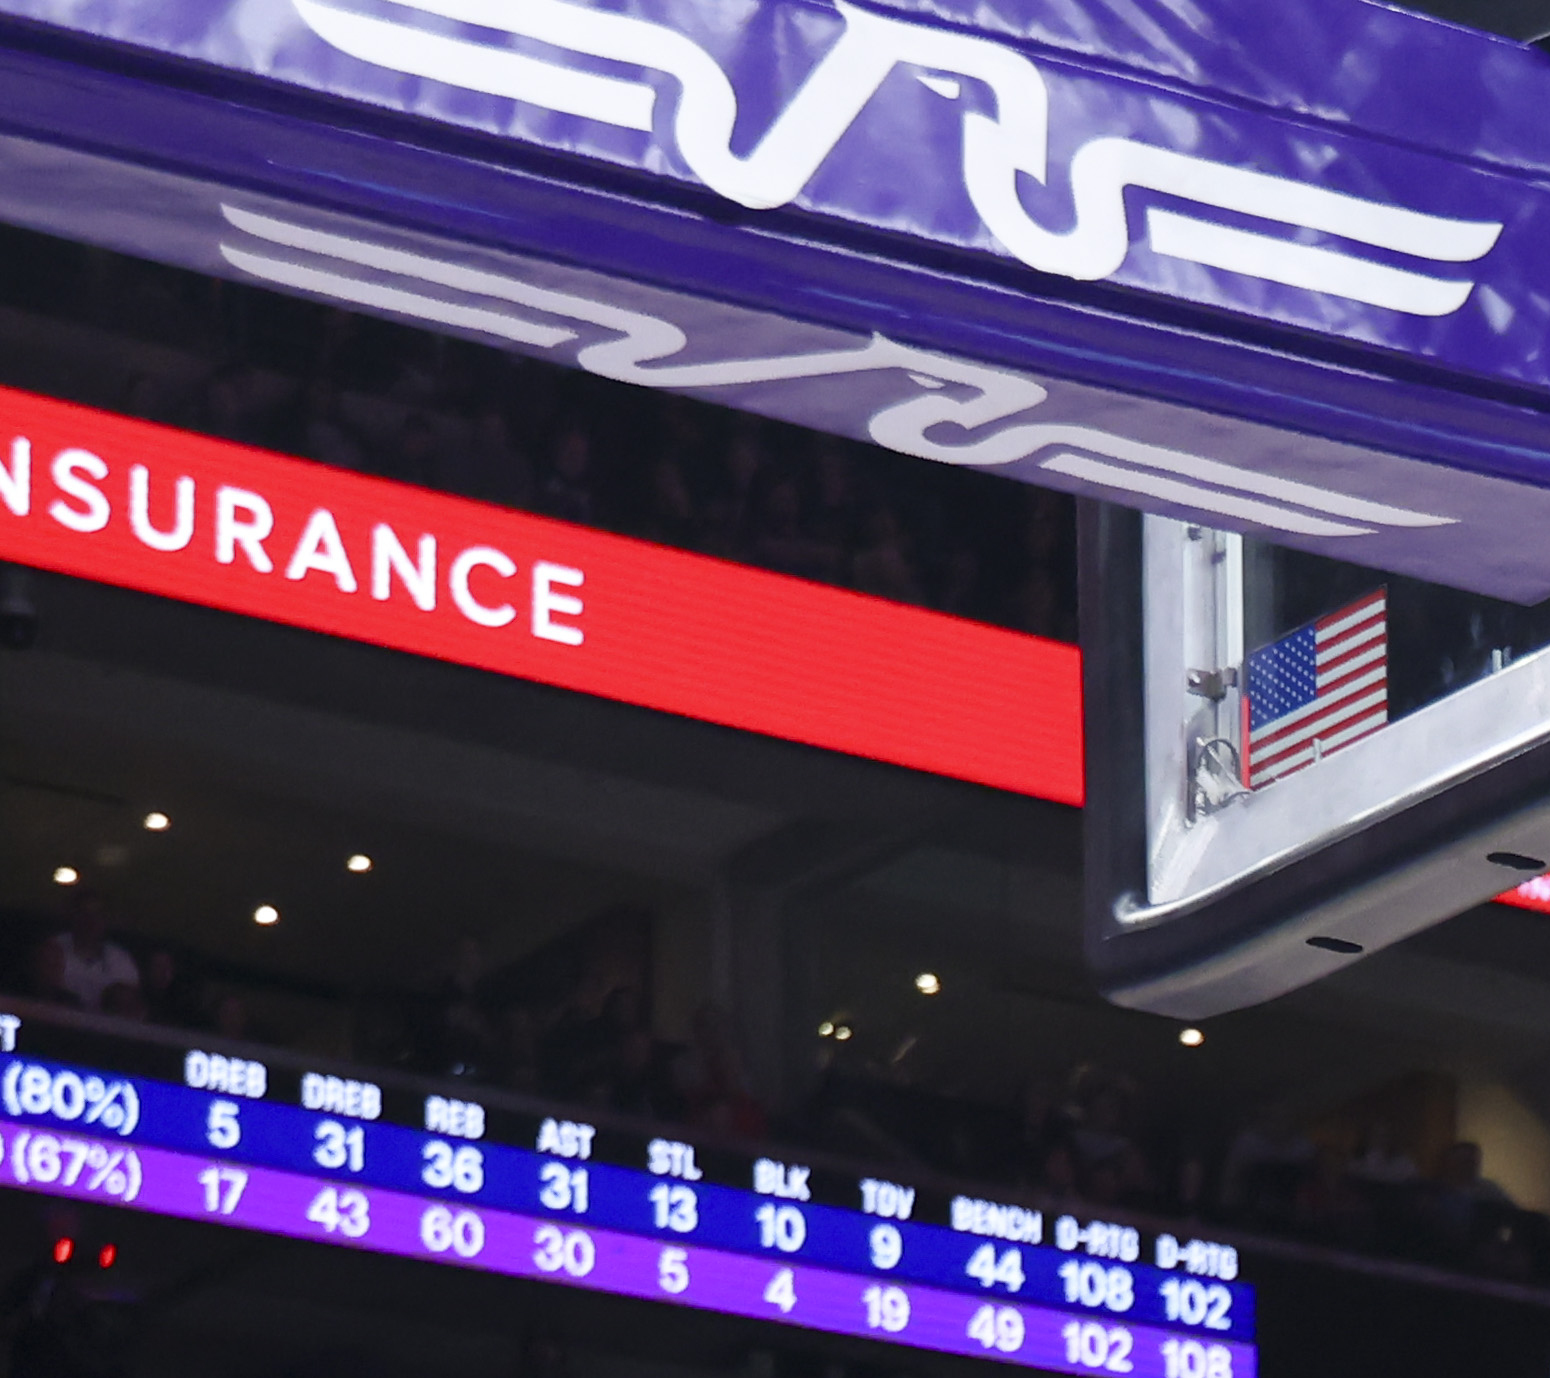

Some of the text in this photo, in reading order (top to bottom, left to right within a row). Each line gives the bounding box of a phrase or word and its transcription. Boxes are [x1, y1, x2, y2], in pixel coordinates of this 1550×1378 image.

[2, 1060, 1232, 1331] (80%) 5 31 36 31 13 10 9 44 108 102
[11, 1129, 143, 1203] (67%)
[199, 1167, 249, 1215] 17
[306, 1186, 370, 1238] 43
[420, 1206, 485, 1258] 60
[532, 1225, 595, 1278] 30
[657, 1246, 689, 1295] 5
[762, 1267, 797, 1314] 4
[862, 1284, 911, 1333] 19
[966, 1304, 1026, 1353] 49
[1062, 1320, 1134, 1373] 102
[424, 1094, 486, 1141] REB
[538, 1117, 596, 1161] AST
[648, 1138, 703, 1182] STL
[753, 1157, 812, 1201] BLK
[860, 1177, 916, 1222] TOV
